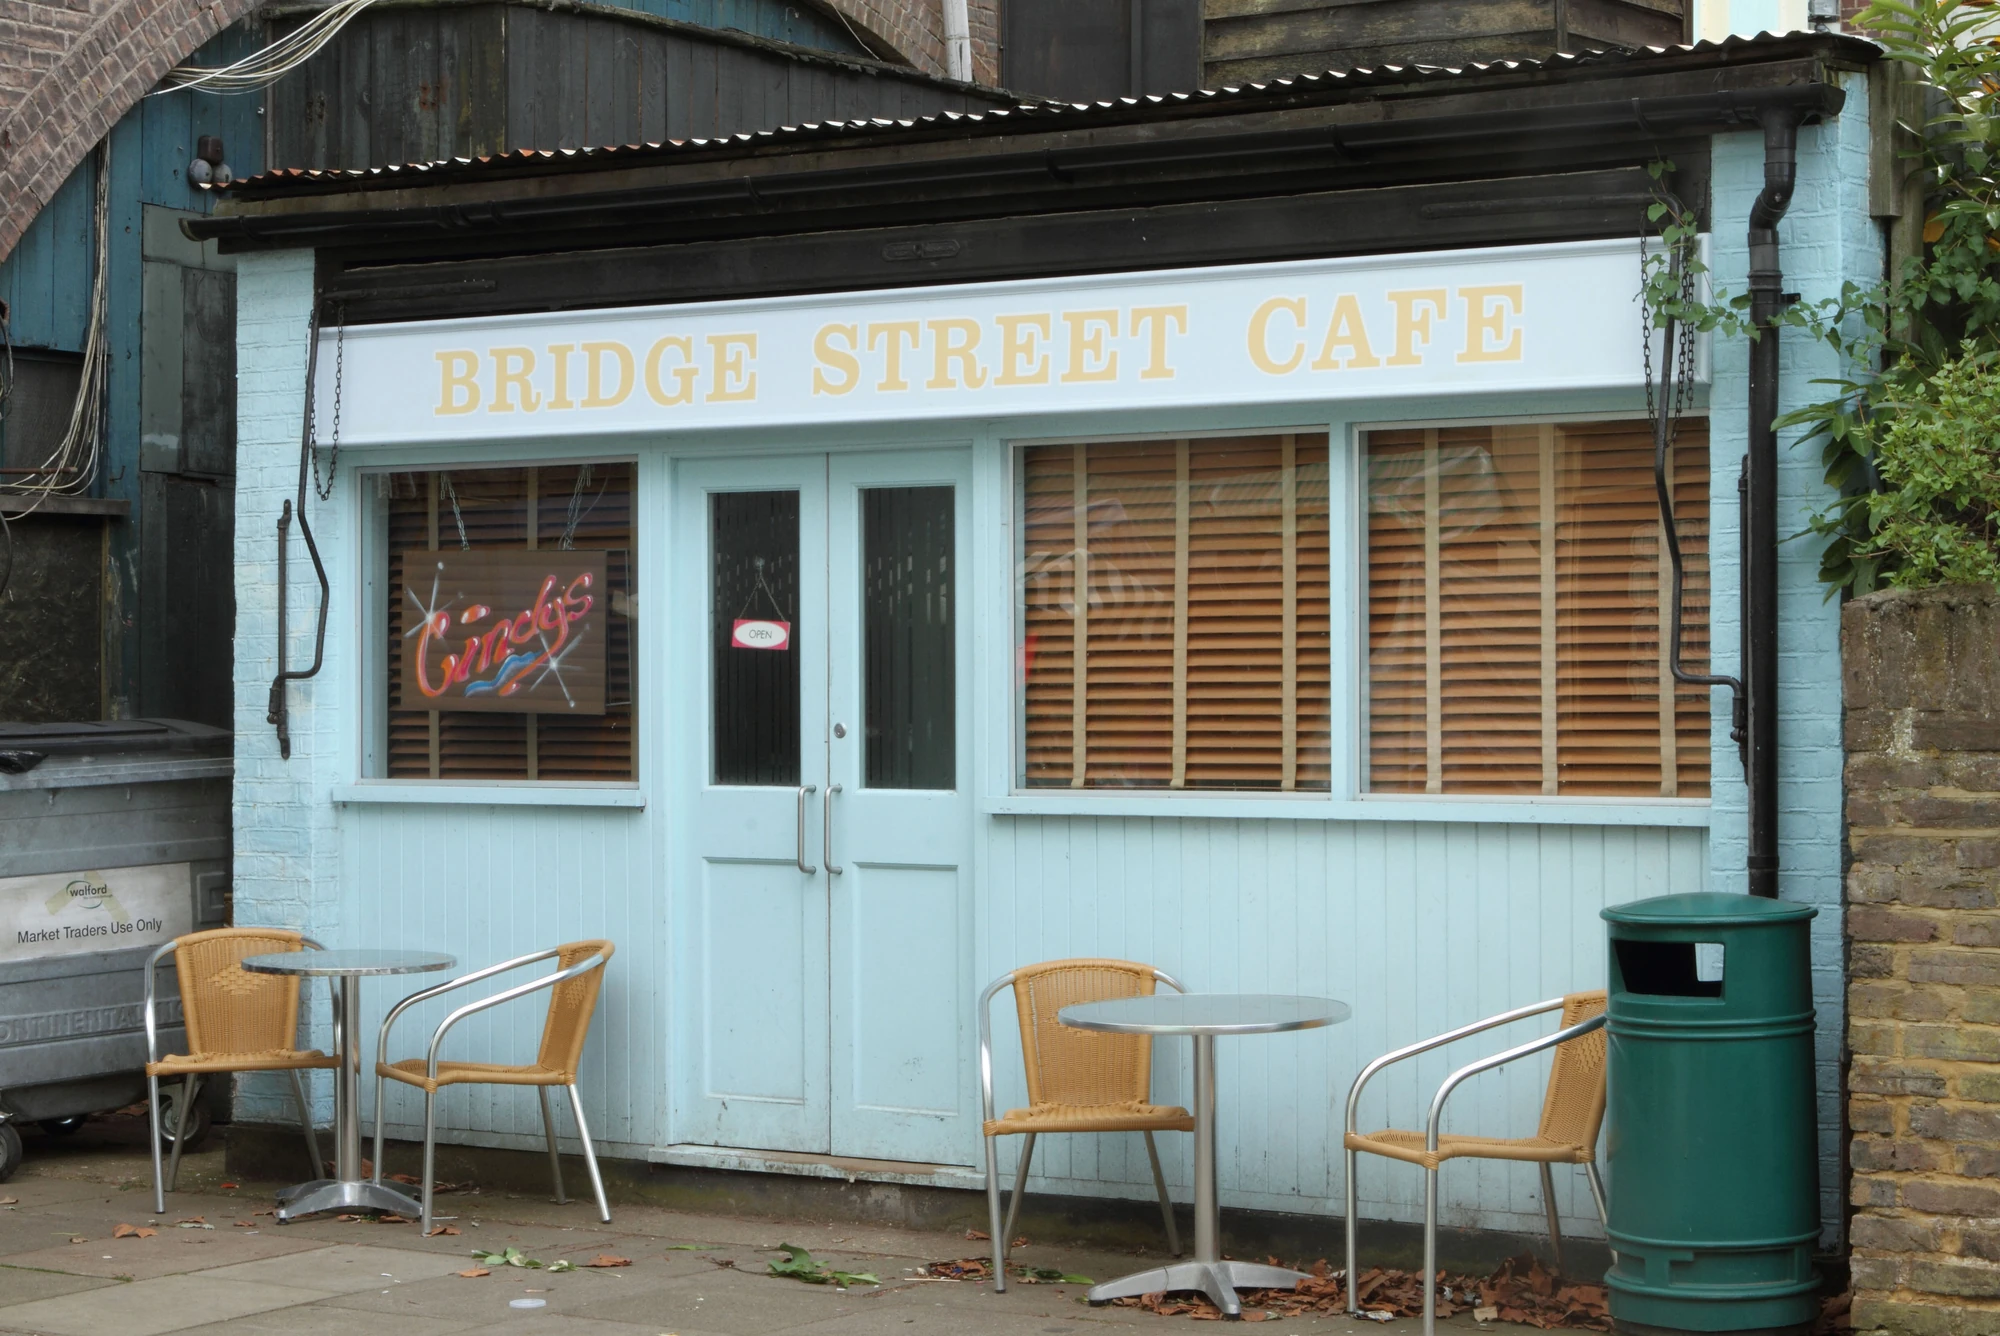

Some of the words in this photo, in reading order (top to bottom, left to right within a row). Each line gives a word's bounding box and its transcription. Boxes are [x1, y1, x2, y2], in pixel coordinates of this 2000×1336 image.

[434, 331, 758, 416] BRIDGE
[812, 304, 1189, 397] STREET
[1246, 283, 1525, 376] CAFE
[749, 629, 772, 639] OPEN
[70, 884, 107, 897] walford
[18, 929, 60, 943] Market
[64, 925, 107, 939] Traders
[111, 922, 133, 934] Use
[137, 918, 162, 933] Only
